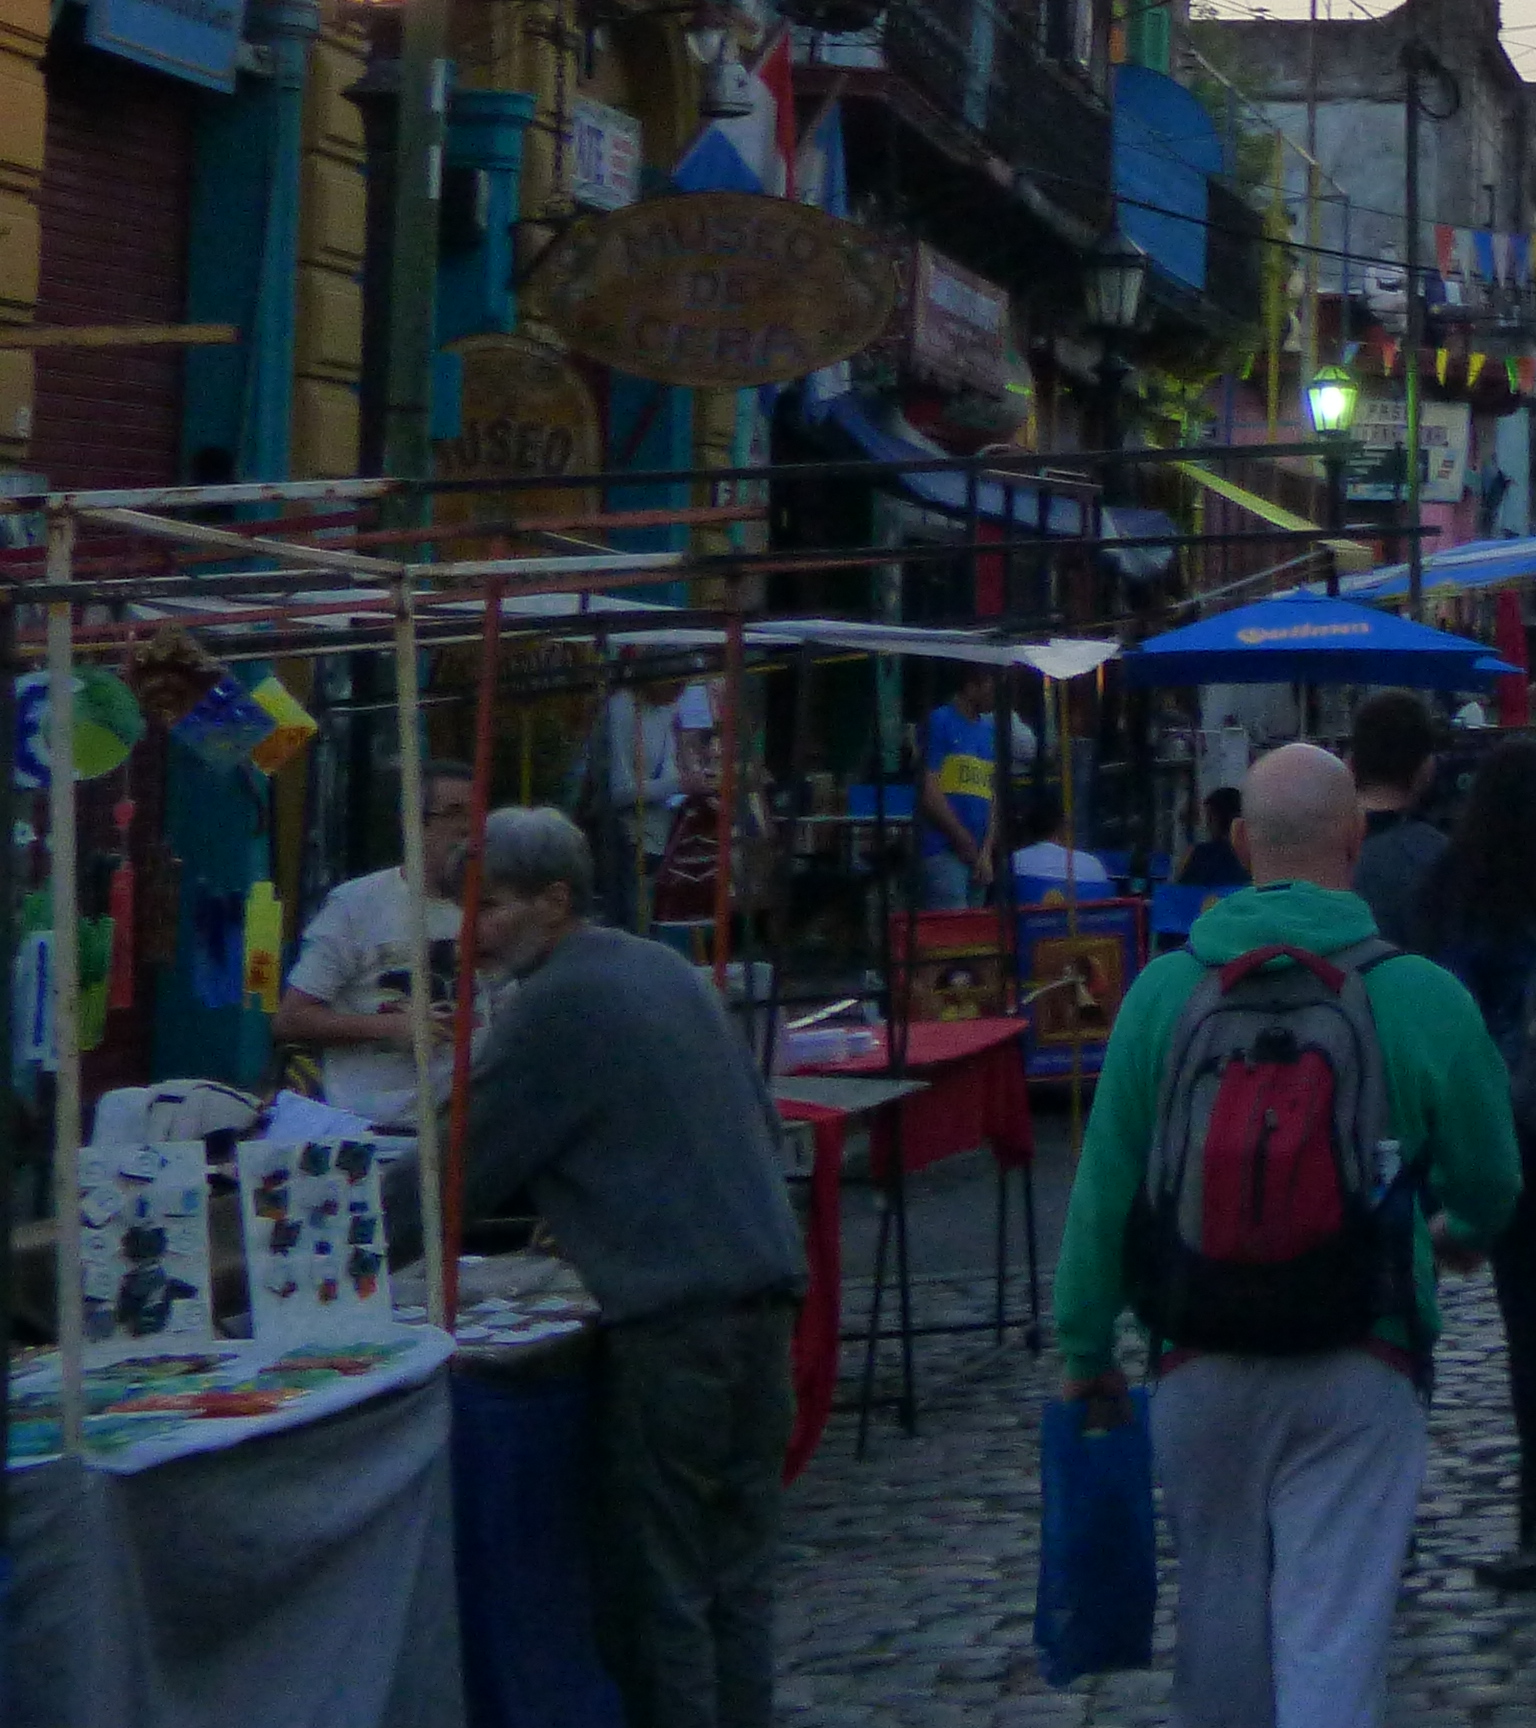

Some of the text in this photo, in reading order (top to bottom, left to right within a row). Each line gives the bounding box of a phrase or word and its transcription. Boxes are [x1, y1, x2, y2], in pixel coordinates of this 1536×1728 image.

[625, 214, 817, 271] MUSEO
[686, 270, 757, 309] DE
[630, 318, 807, 367] CERA
